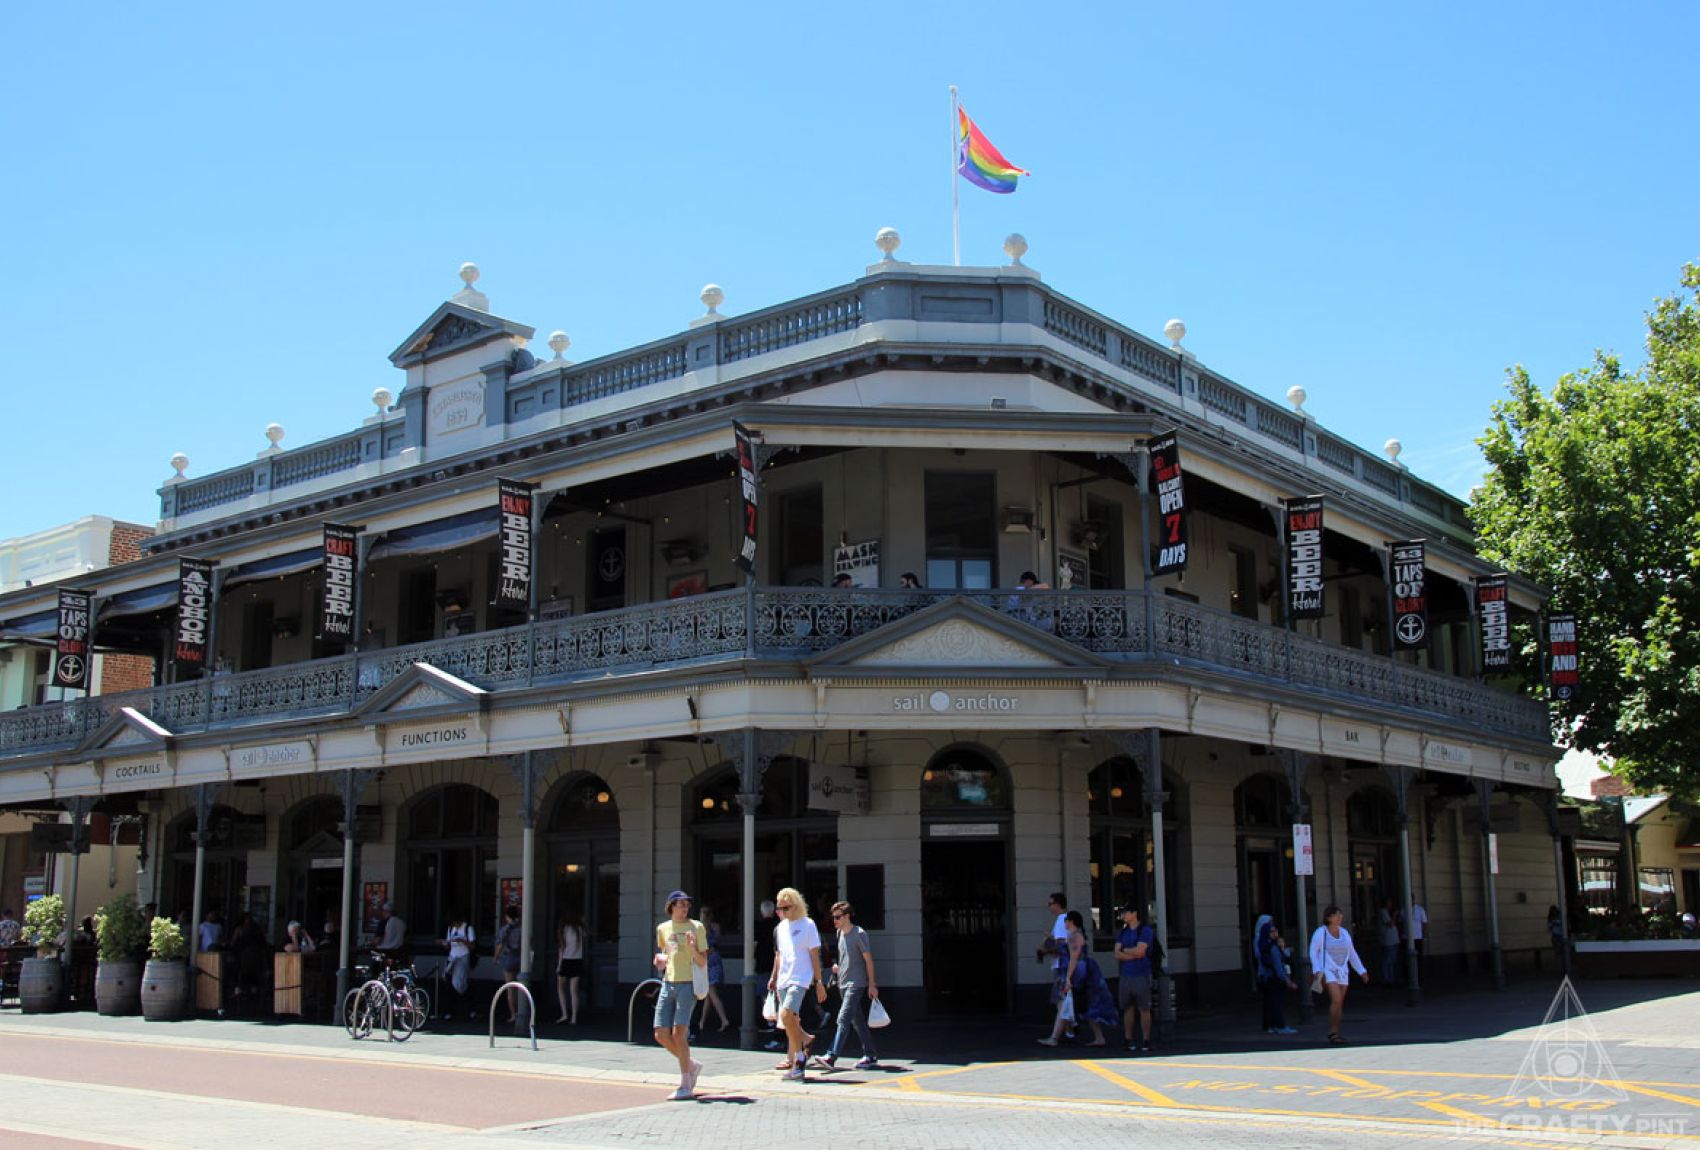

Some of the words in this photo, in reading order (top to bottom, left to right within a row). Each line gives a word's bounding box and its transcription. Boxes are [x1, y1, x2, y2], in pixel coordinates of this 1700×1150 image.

[1160, 488, 1183, 514] OPEN
[1166, 513, 1182, 543] 7
[326, 538, 353, 556] CRAFT
[502, 512, 530, 582] BEER
[1159, 543, 1186, 567] DAYS
[1291, 529, 1324, 593] BEER
[1394, 564, 1424, 582] TAPS
[325, 553, 354, 616] BEER
[1395, 581, 1424, 598] OF
[60, 609, 88, 626] TAPS
[179, 571, 208, 645] ANCHOR
[60, 625, 88, 640] OF
[1480, 600, 1511, 651] BEER
[1551, 654, 1578, 671] AND
[893, 693, 924, 710] sail
[954, 693, 1019, 711] anchor
[401, 727, 468, 747] FUNCTIONS
[115, 763, 161, 779] COCKTAILS
